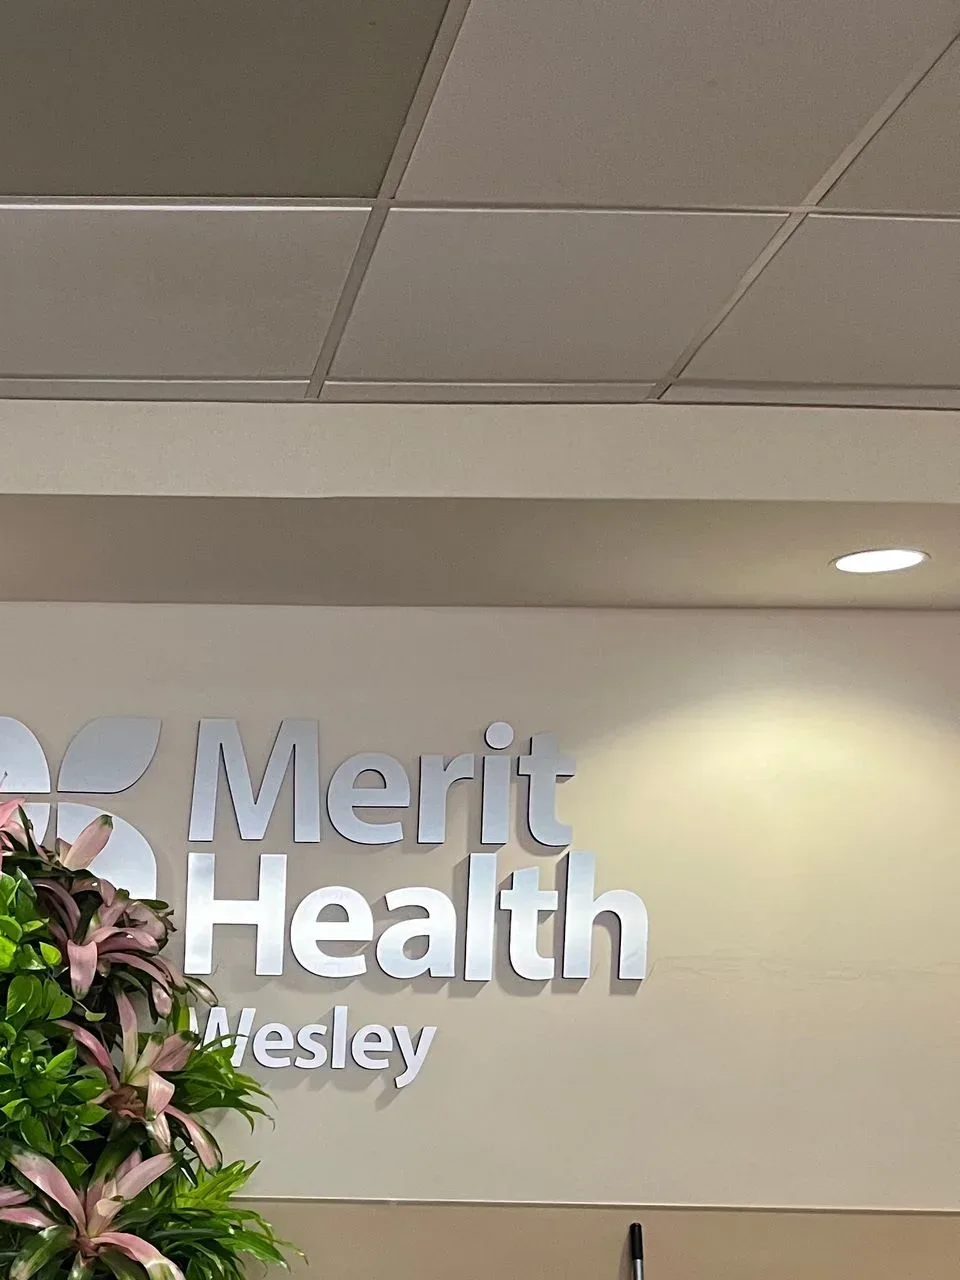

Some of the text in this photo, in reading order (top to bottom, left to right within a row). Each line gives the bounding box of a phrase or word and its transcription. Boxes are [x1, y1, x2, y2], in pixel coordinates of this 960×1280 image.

[188, 718, 577, 846] Merit
[184, 851, 649, 982] Health
[190, 1006, 437, 1089] Wesley
